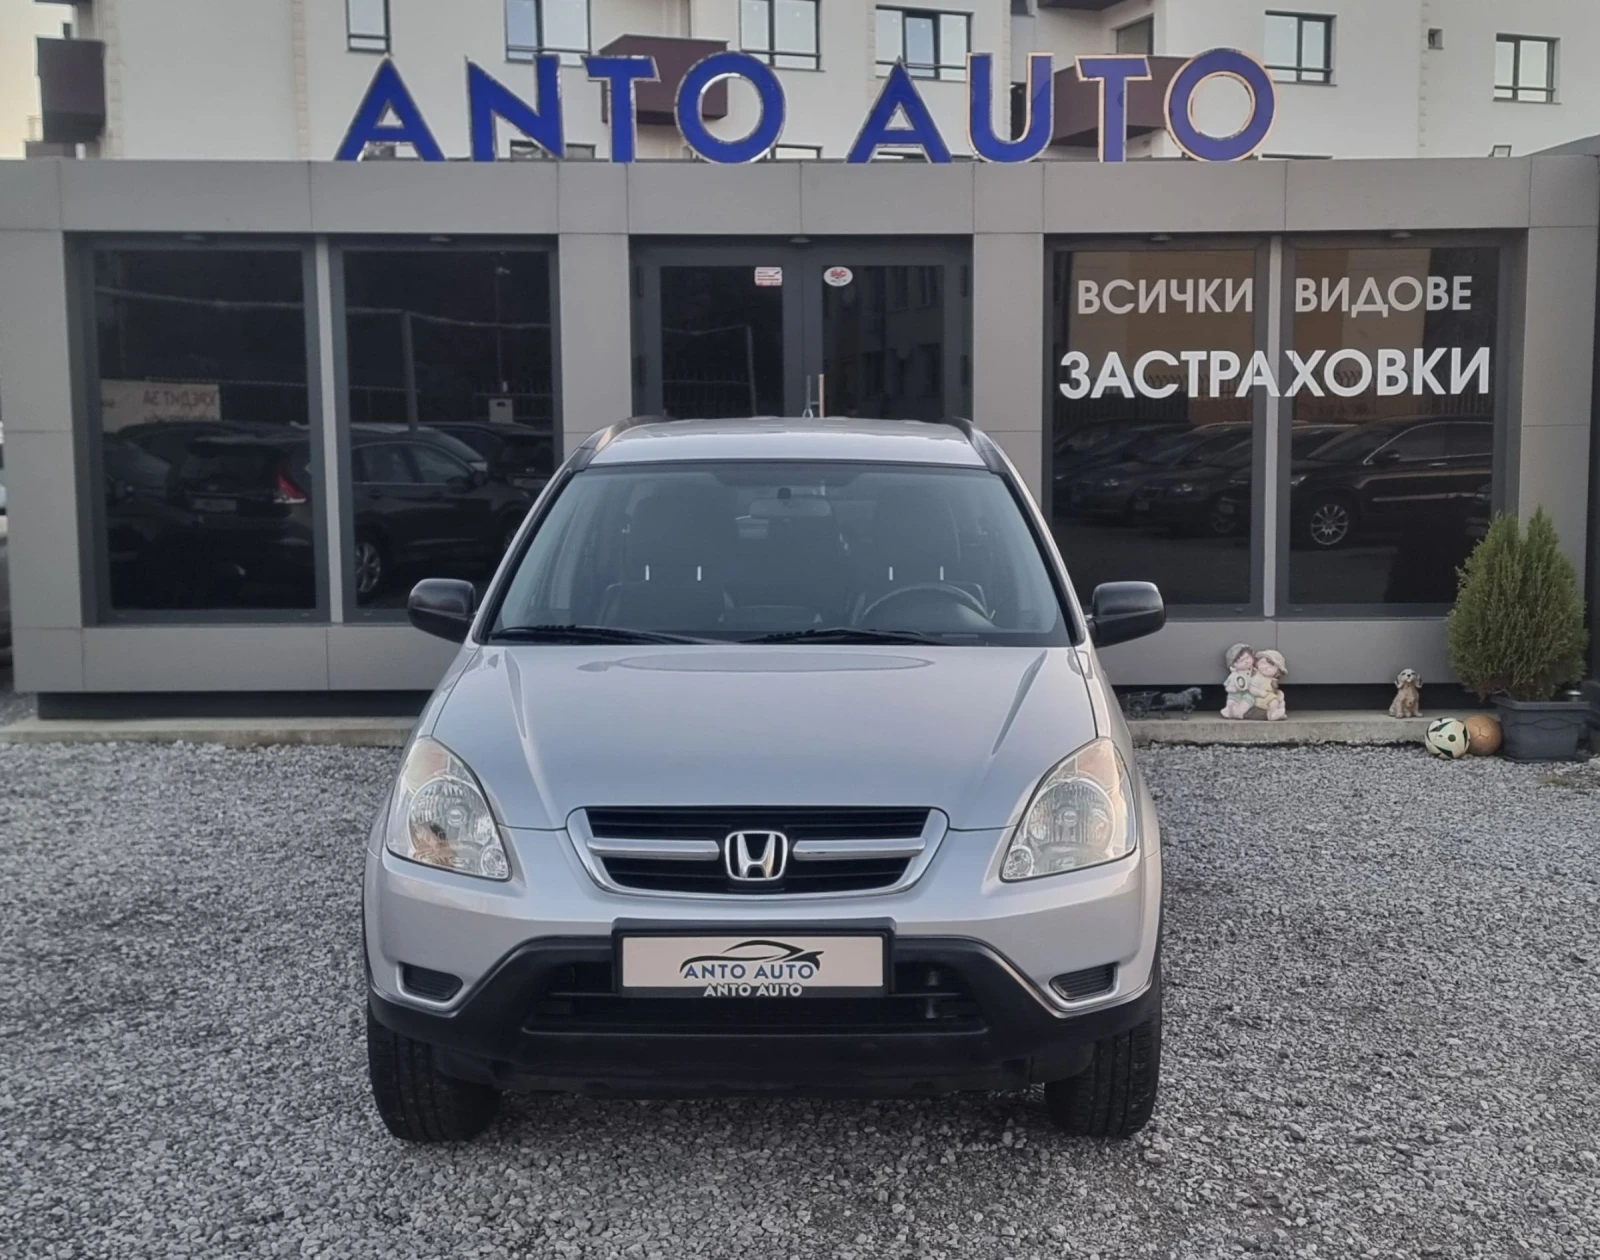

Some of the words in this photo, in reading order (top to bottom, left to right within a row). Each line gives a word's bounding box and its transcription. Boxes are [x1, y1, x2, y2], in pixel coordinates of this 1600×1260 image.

[334, 51, 786, 164] ANTO
[847, 48, 1277, 163] AUTO
[1077, 278, 1253, 315] ВСИЧКИ
[1295, 275, 1472, 318] ВИДОВЕ
[1059, 347, 1491, 399] ЗАСТРАХОВКИ
[685, 964, 746, 979] ANTO
[755, 964, 814, 979] AUTO
[704, 984, 751, 997] ANTO
[757, 984, 802, 997] AUTO
